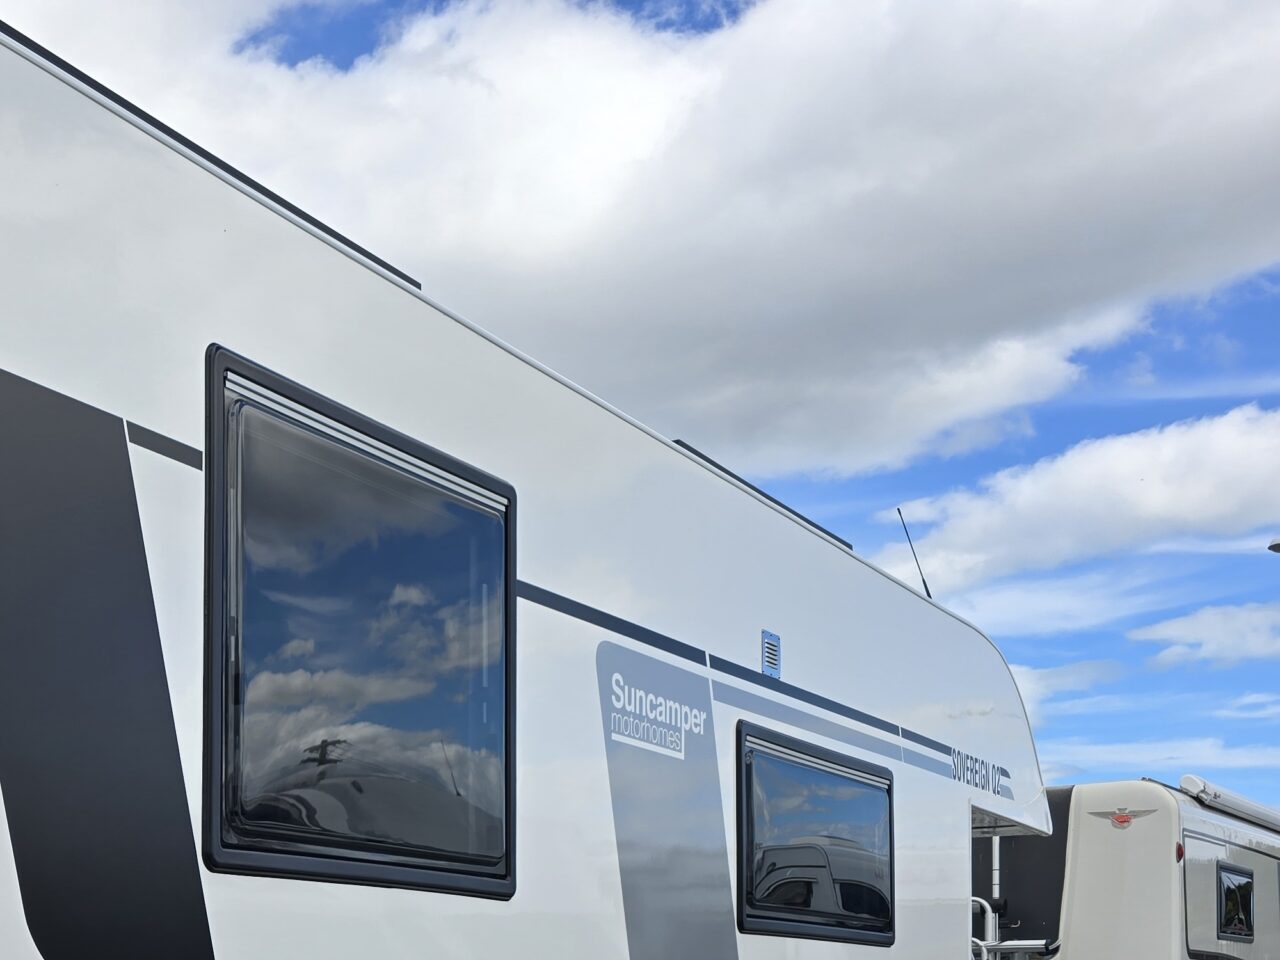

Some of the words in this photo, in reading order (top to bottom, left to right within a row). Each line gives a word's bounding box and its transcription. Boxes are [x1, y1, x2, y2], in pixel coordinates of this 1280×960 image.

[611, 672, 707, 744] Suncamper
[611, 712, 681, 750] motorhomes
[952, 747, 990, 793] SOVEREIGN
